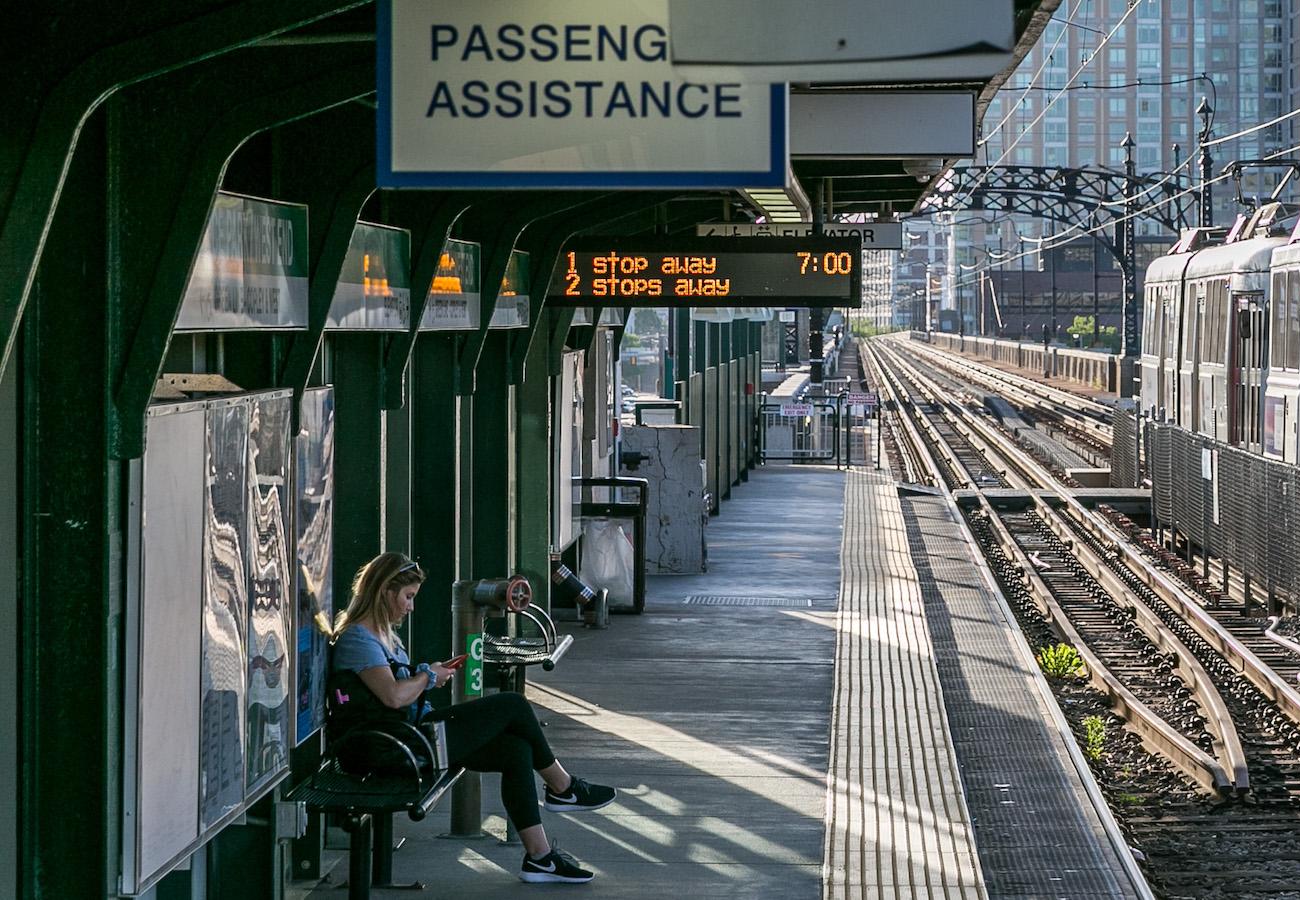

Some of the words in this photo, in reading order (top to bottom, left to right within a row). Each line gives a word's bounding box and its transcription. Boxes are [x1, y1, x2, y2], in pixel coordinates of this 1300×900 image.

[426, 80, 742, 119] ASSISTANCE
[567, 251, 577, 274] 1
[593, 251, 648, 274] stop
[661, 256, 716, 274] away
[796, 252, 852, 275] 7:00
[565, 273, 581, 296] 2
[592, 273, 662, 296] stops
[674, 277, 730, 296] away
